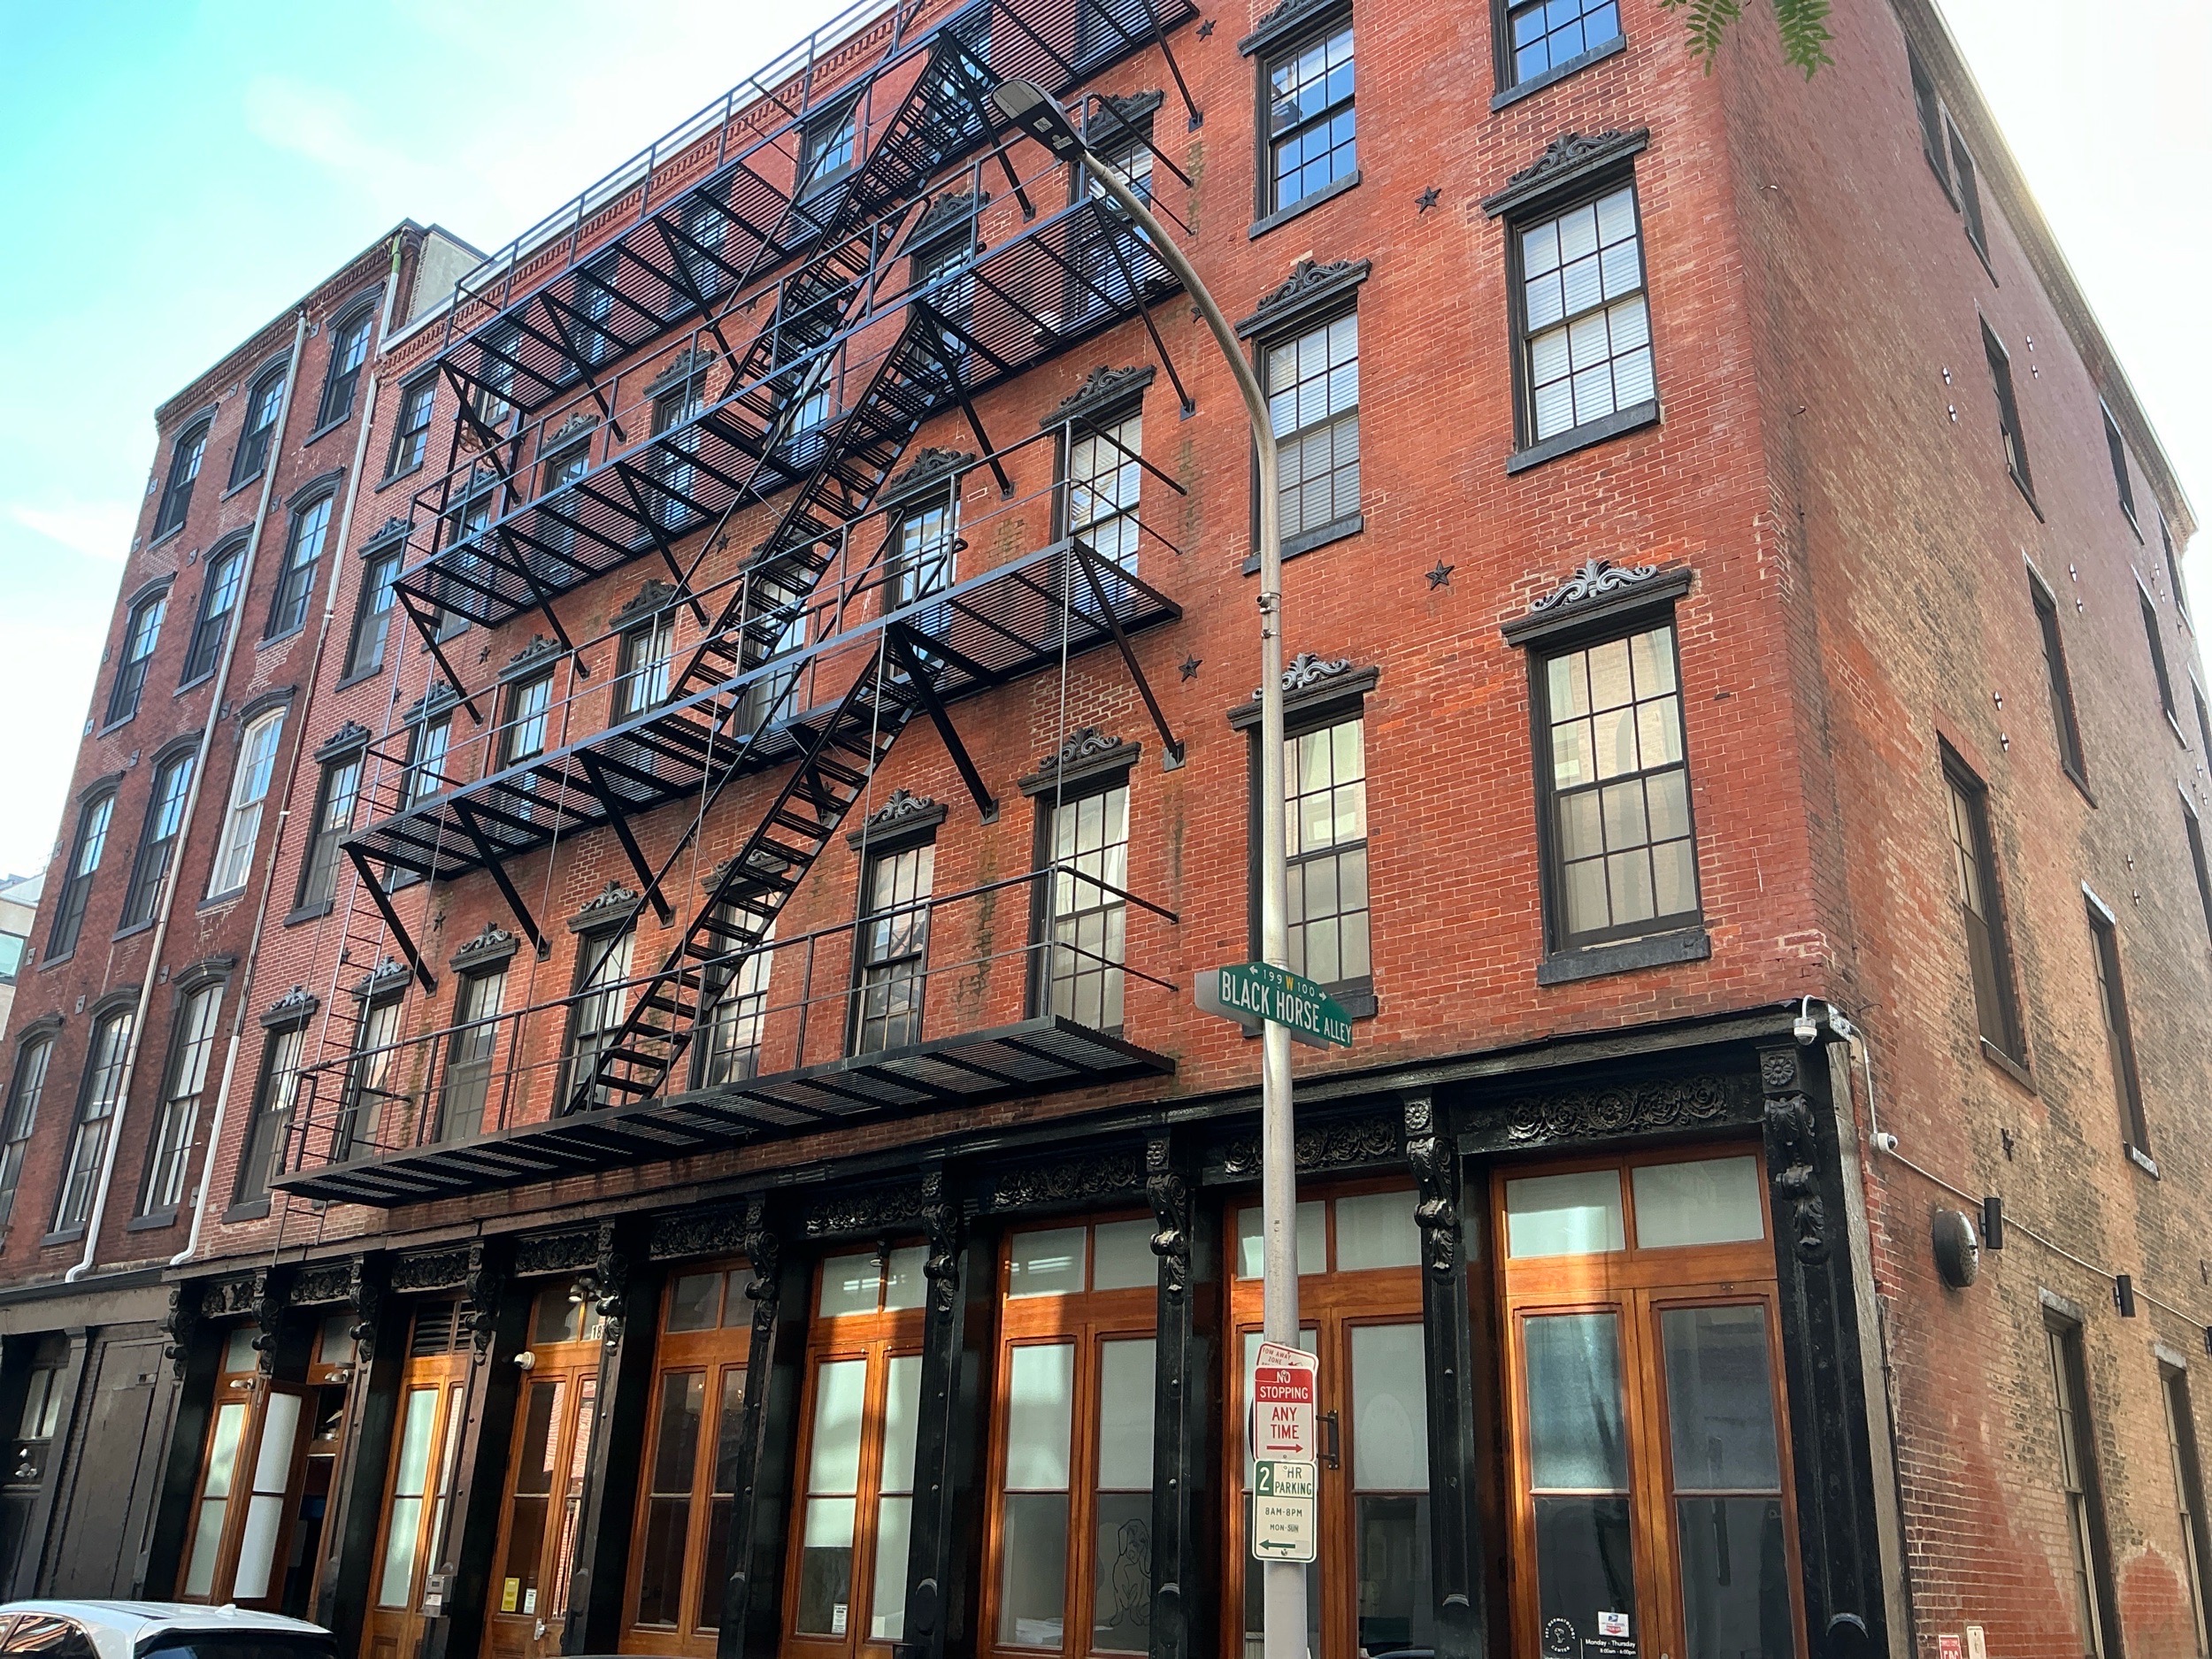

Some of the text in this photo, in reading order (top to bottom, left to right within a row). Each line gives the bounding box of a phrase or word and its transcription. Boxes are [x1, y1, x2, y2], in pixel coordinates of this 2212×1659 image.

[1263, 969, 1315, 997] 199 W 100
[1222, 971, 1352, 1044] BLACK HORSE ALLEY
[1268, 1356, 1282, 1365] ZONE
[1275, 1351, 1292, 1360] AWAY
[1277, 1371, 1291, 1384] NO
[1259, 1386, 1309, 1400] STOPPING
[1271, 1406, 1298, 1422] ANY
[1270, 1424, 1300, 1440] TIME
[1259, 1466, 1302, 1491] 2 HR
[1274, 1481, 1312, 1495] PARKING
[1264, 1507, 1302, 1517] 8AM-8PM
[1270, 1524, 1299, 1532] MON-SUN
[1585, 1638, 1607, 1647] Monday
[1611, 1640, 1636, 1649] Thursday
